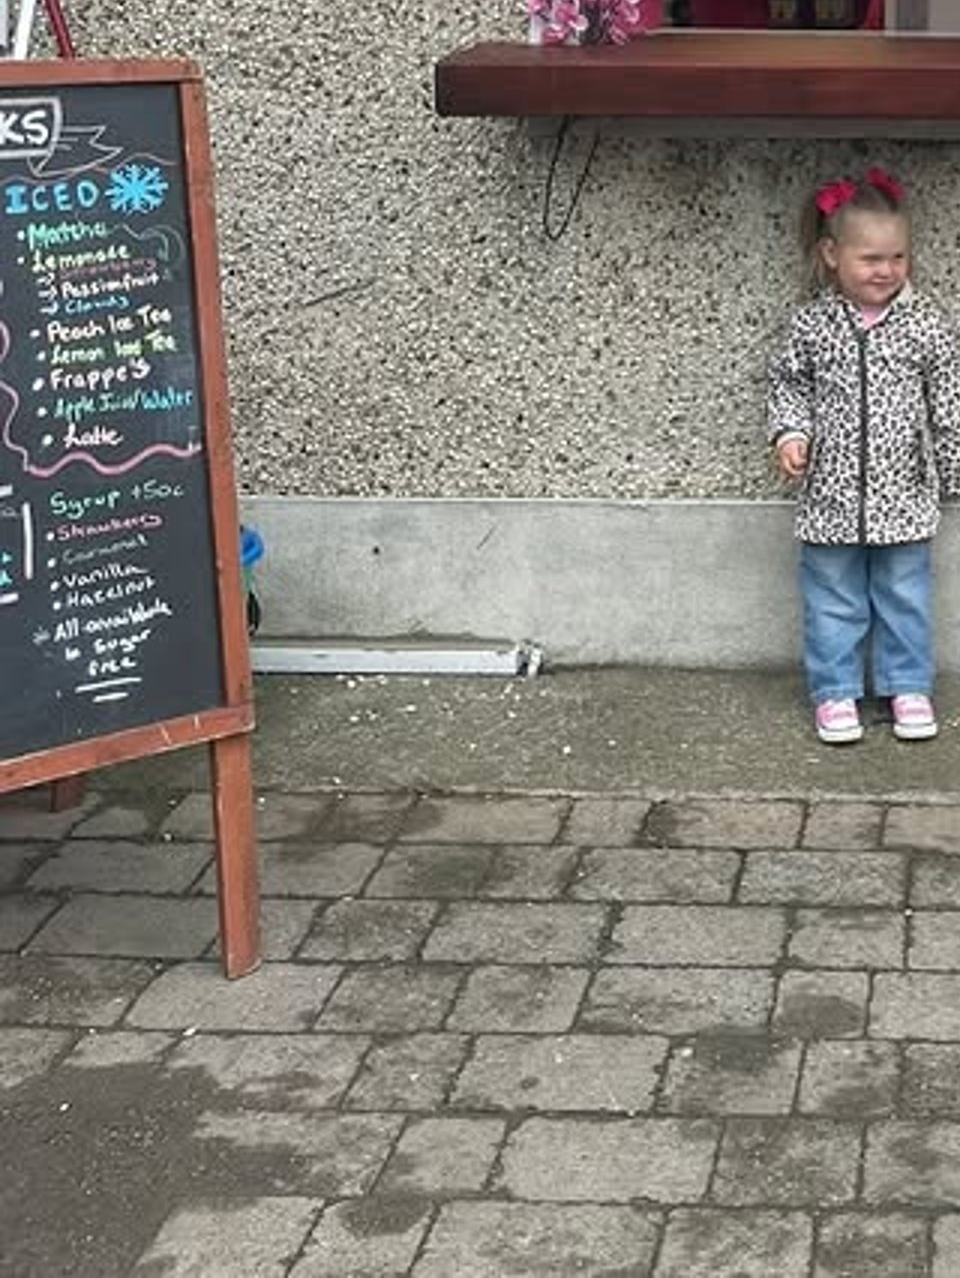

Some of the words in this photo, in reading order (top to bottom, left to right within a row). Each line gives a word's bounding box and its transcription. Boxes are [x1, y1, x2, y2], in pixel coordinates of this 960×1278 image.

[5, 179, 99, 214] ICED
[32, 245, 130, 273] Lemonade
[47, 320, 105, 343] Peach
[50, 491, 121, 520] Syrup
[63, 562, 150, 588] Vanilla
[54, 617, 79, 642] All
